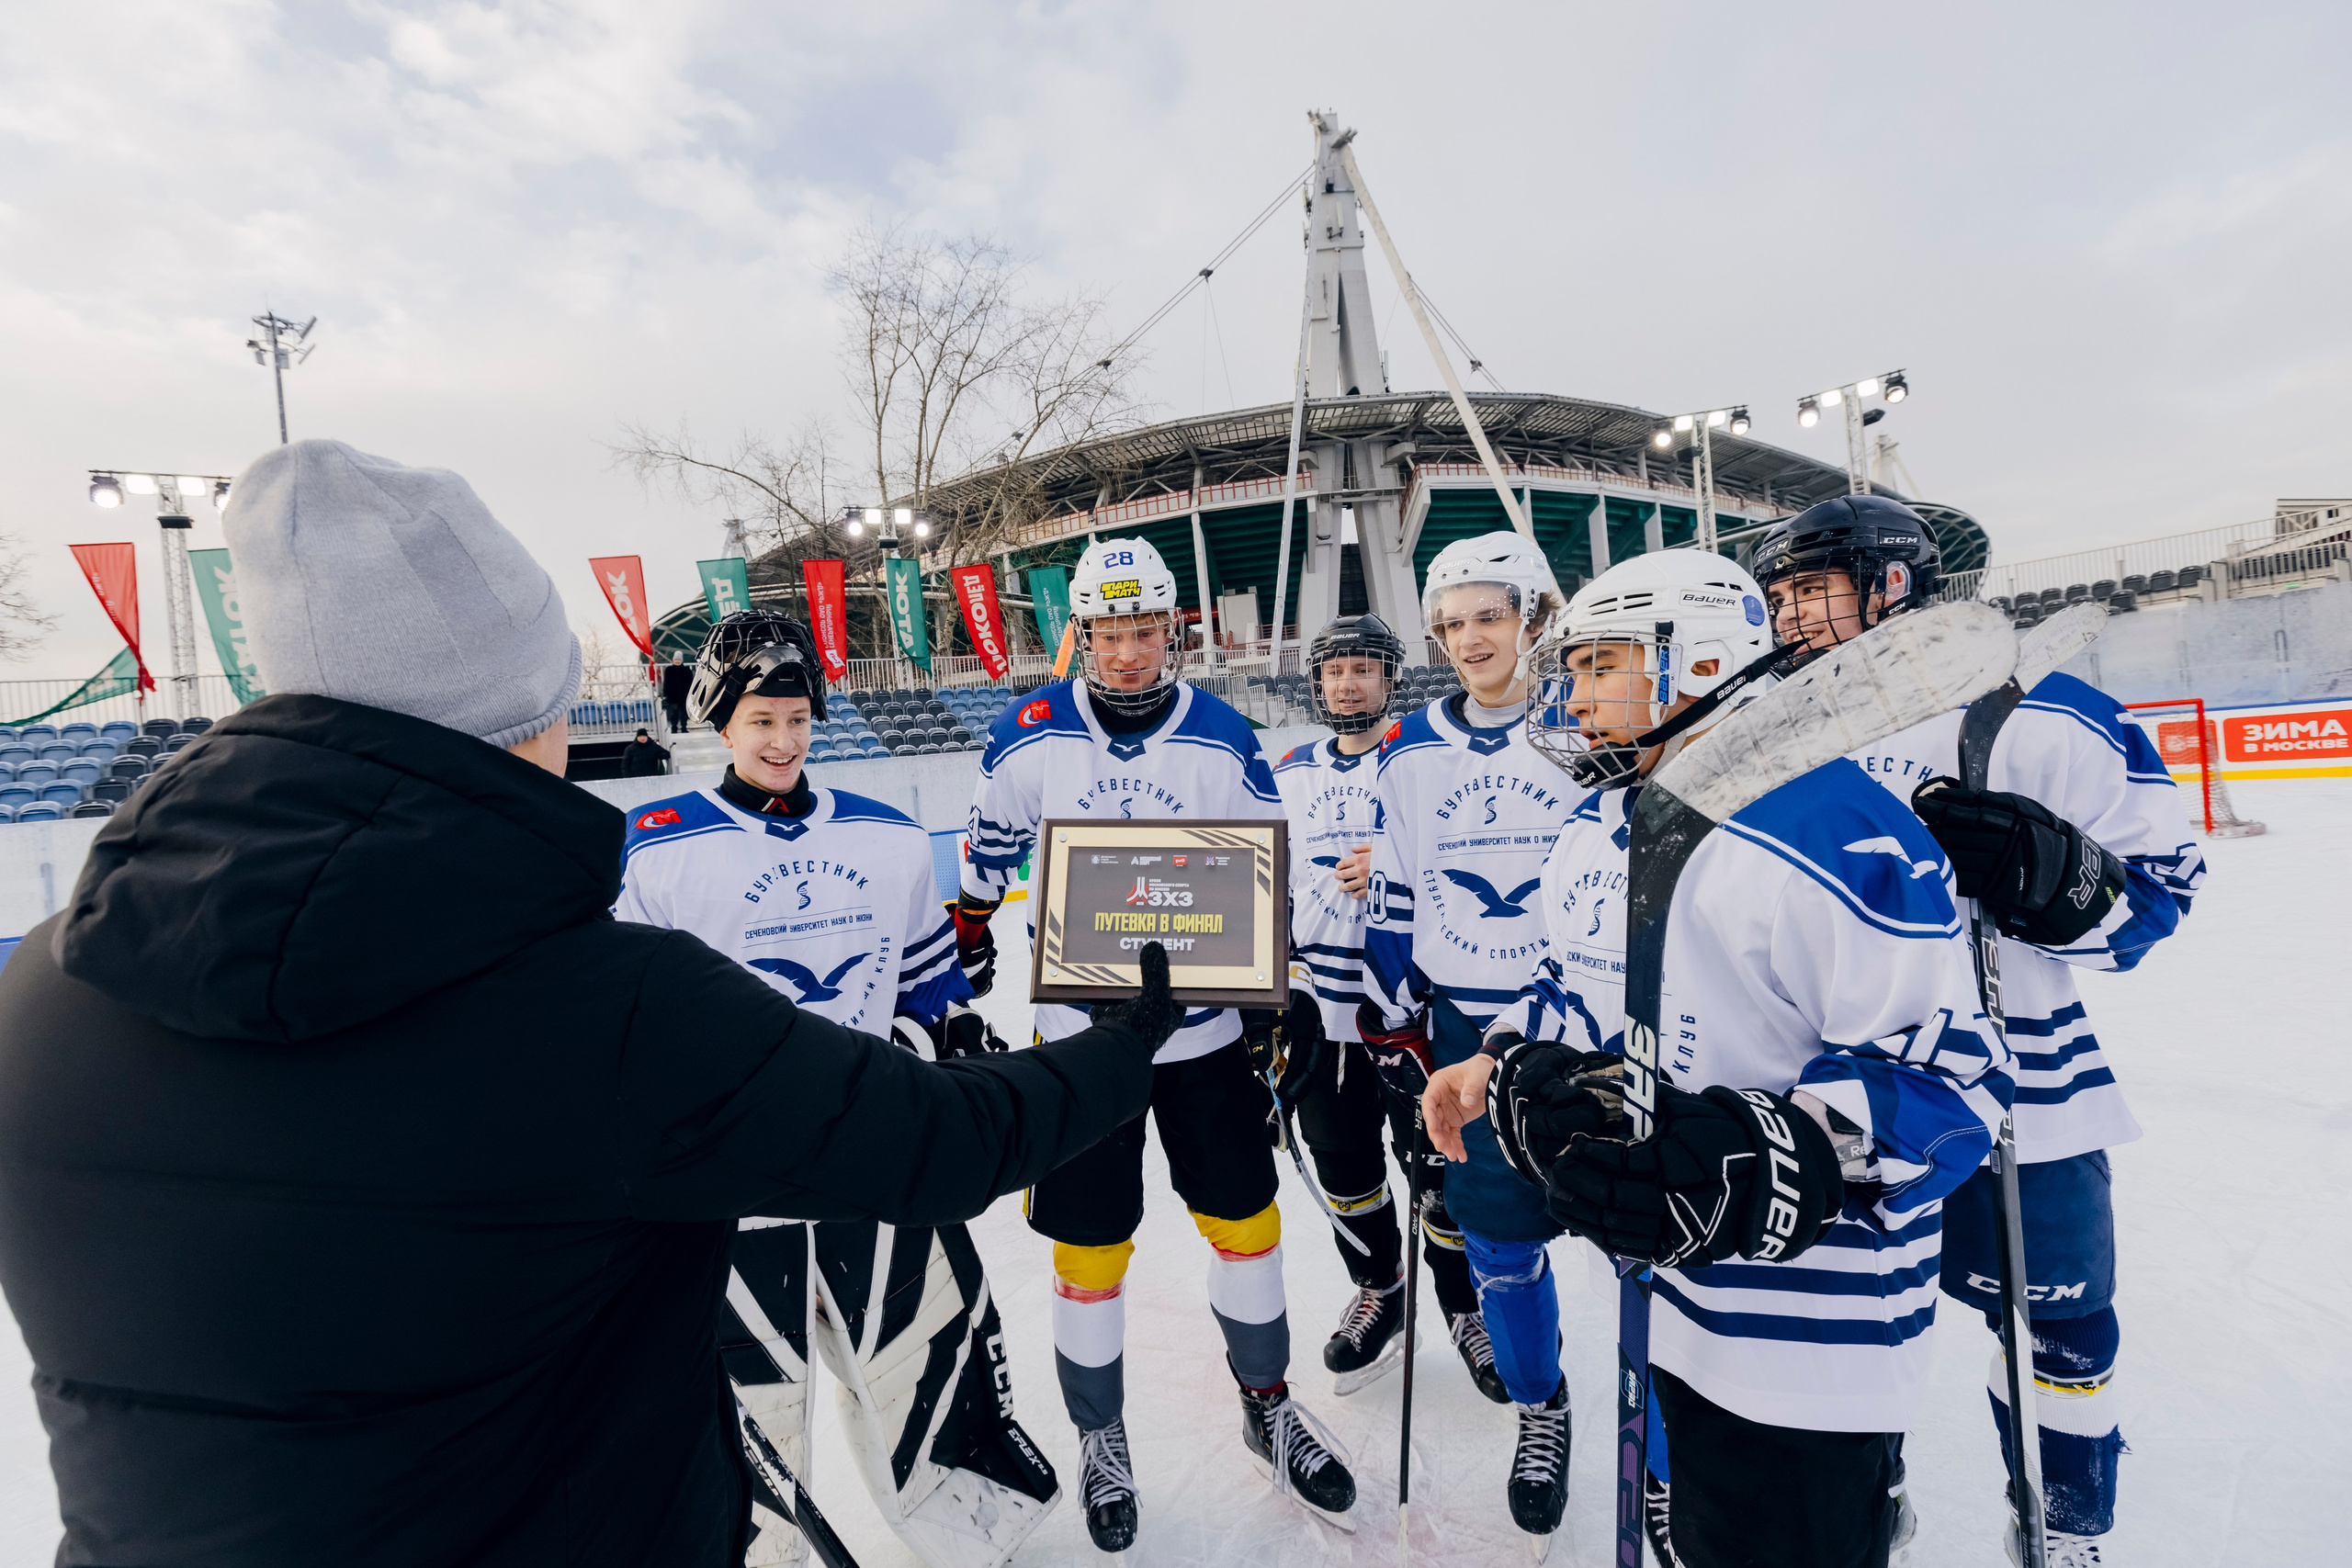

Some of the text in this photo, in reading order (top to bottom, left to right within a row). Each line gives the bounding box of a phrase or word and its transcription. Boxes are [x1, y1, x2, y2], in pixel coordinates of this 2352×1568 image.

[1883, 536, 1918, 544] CCM
[1102, 551, 1134, 569] 28
[1756, 539, 1789, 562] CCM
[1102, 581, 1138, 592] ПАРИ
[1104, 588, 1141, 599] МАТЧ
[1888, 602, 1906, 615] CCM
[2242, 718, 2348, 741] ЗИМА
[2245, 738, 2349, 753] В МОСКВЕ
[1469, 836, 1511, 847] УНИВЕРСИТЕТ
[1513, 835, 1532, 844] НАУК
[1533, 835, 1539, 843] О
[744, 860, 869, 904] БУРВЕСТНИК
[831, 916, 847, 927] НАУК
[848, 915, 854, 924] О
[1094, 912, 1223, 933] ПУТЕВКА В ФИНАЛ
[1119, 937, 1195, 952] СТУЕНТ
[875, 937, 890, 974] КЛУБ
[1671, 1013, 1696, 1074] КЛУБ
[1737, 1089, 1801, 1260] BAUER
[1966, 1271, 2086, 1302] CCM
[986, 1330, 1014, 1419] CCM
